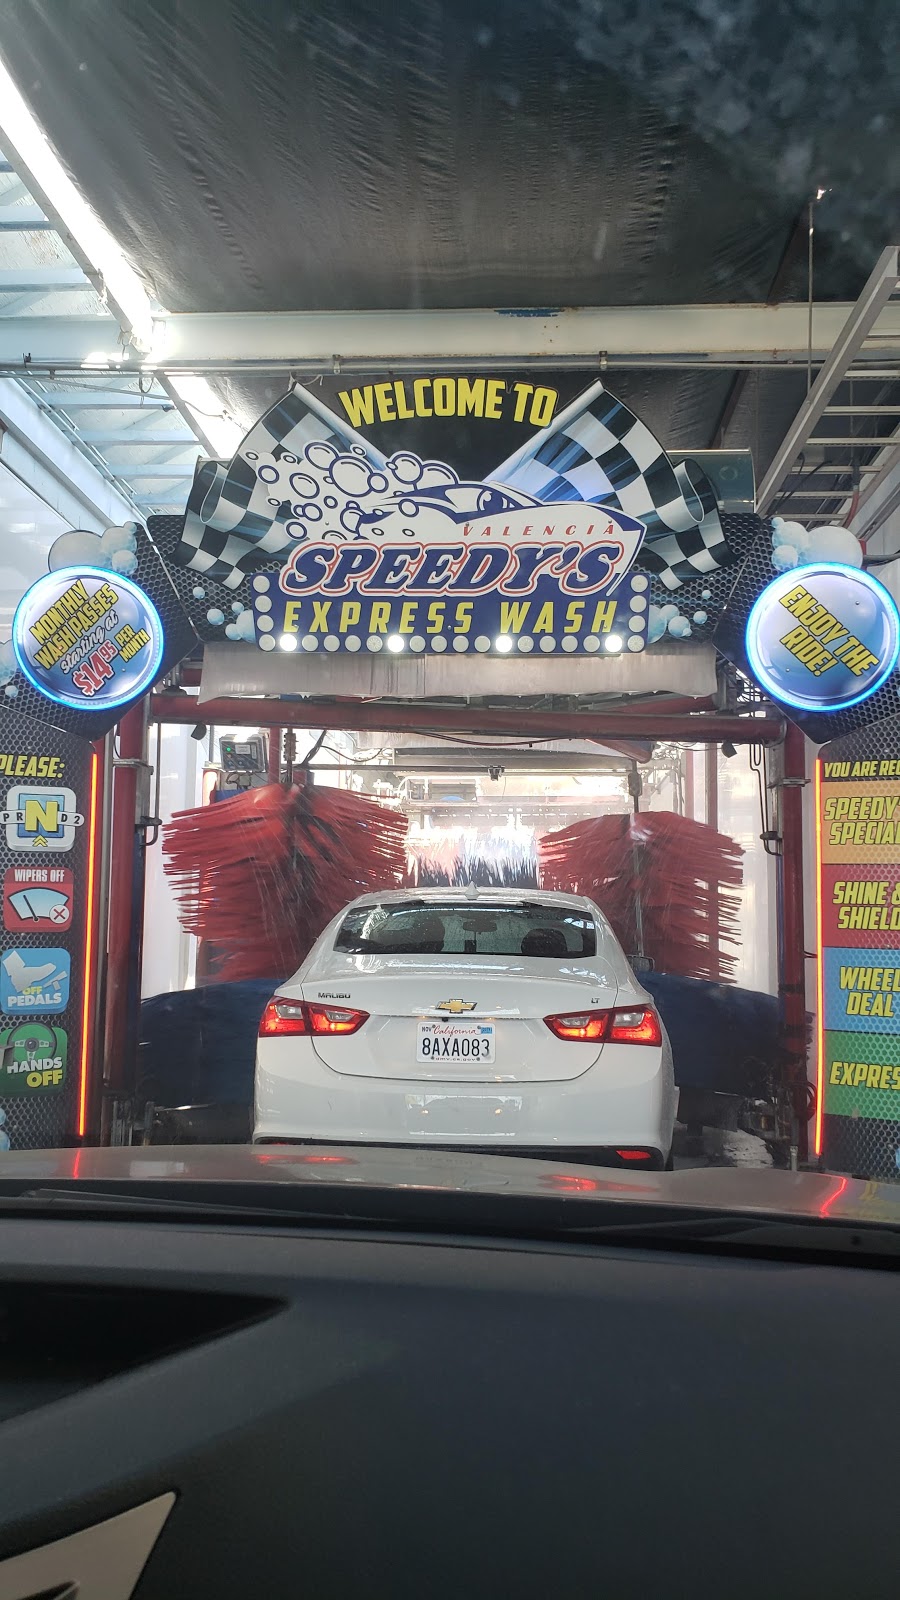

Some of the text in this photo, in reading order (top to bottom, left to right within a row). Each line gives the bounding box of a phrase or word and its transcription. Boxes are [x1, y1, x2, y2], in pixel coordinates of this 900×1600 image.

[338, 378, 558, 428] WELCOME TO
[462, 523, 617, 537] VALENCIA
[281, 542, 624, 596] SPEEDY'S
[29, 579, 90, 645] MONTHLY
[283, 601, 618, 634] EXPRESS WASH
[33, 583, 119, 670] WASH PASSES
[114, 624, 136, 646] PER
[778, 585, 880, 677] ENJOY THE
[60, 609, 119, 674] starting at
[119, 628, 151, 663] MONTH
[779, 625, 839, 677] RIDE!
[0, 754, 65, 778] PLEASE:
[824, 762, 851, 778] YOU
[851, 760, 879, 777] ARE
[3, 800, 80, 832] P R N D 2
[14, 868, 65, 883] WIPERS OFF
[833, 881, 890, 905] SHINE
[7, 992, 62, 1008] PEDALS
[22, 985, 43, 996] OFF
[846, 991, 895, 1017] DEAL
[433, 1023, 477, 1038] California
[421, 1037, 490, 1058] 8AXA083
[7, 1056, 63, 1074] HANDS
[26, 1069, 63, 1088] OFF
